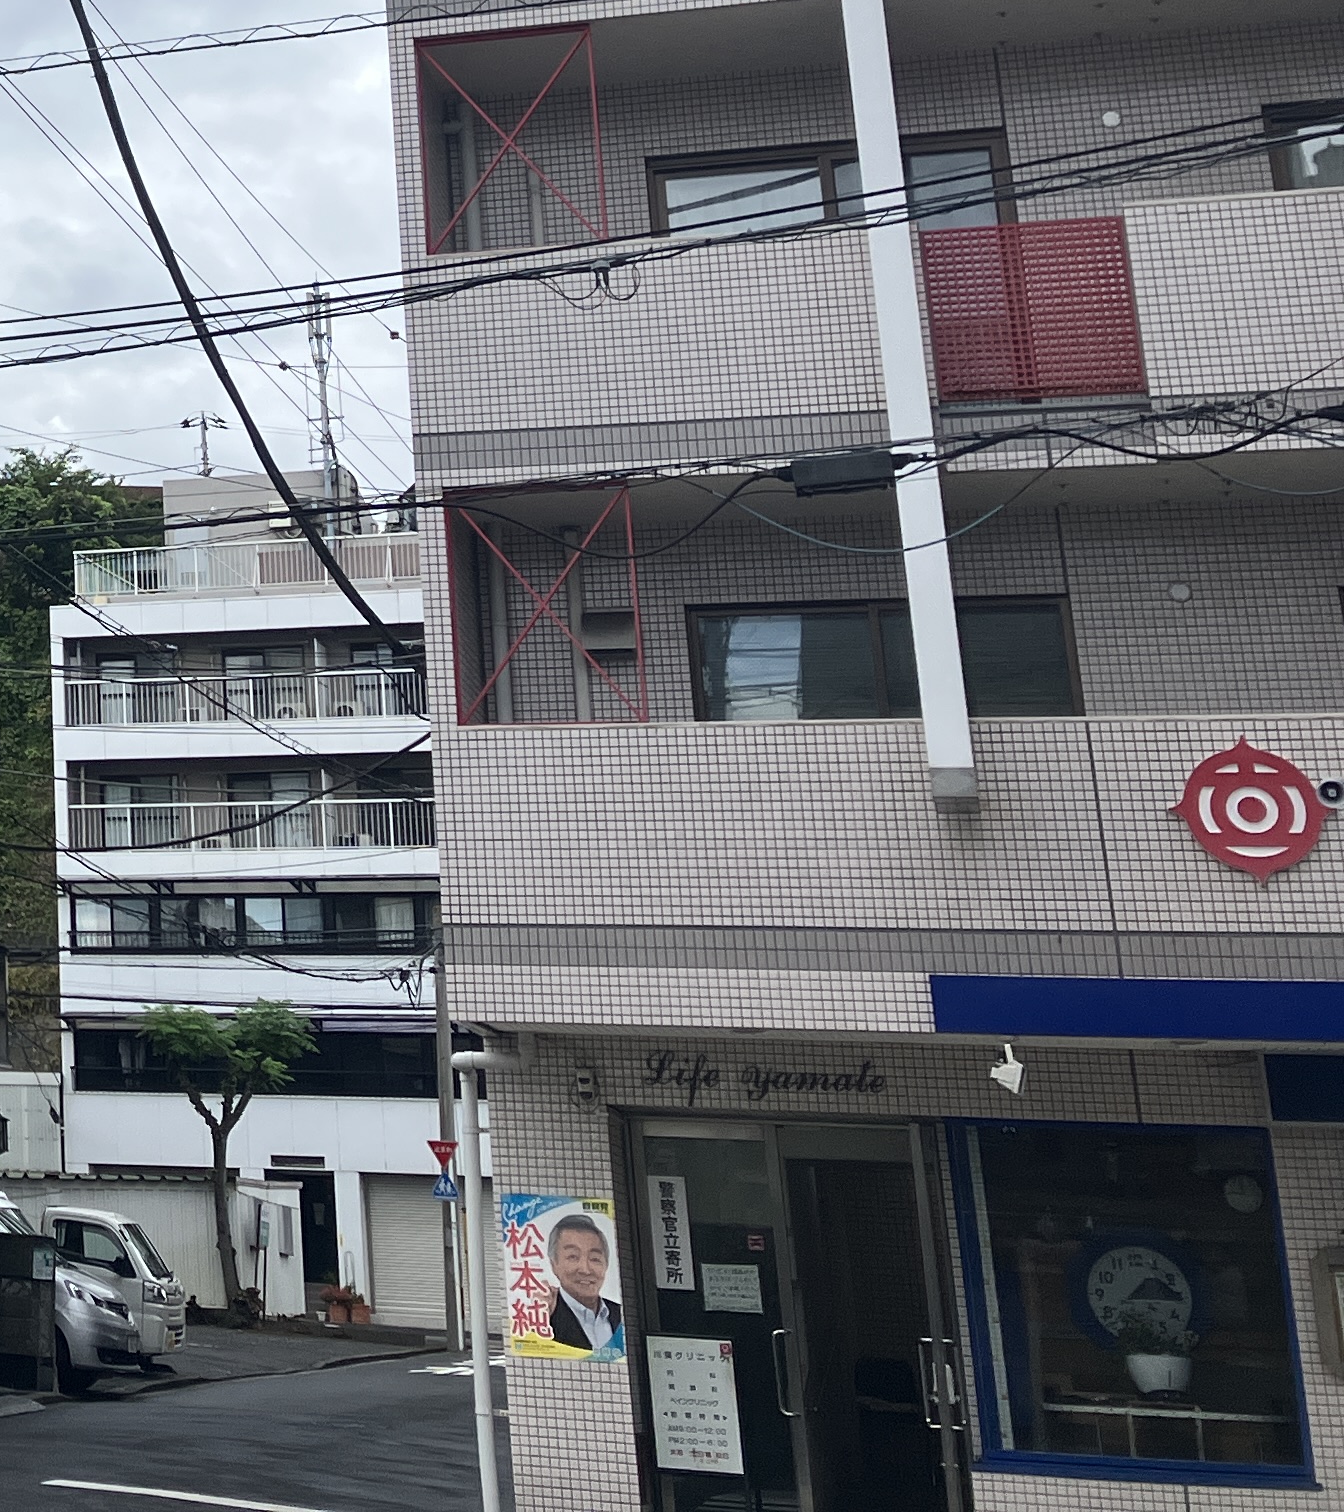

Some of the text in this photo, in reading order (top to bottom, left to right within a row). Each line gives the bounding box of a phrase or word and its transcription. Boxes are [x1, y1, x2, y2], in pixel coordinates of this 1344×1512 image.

[644, 1048, 721, 1107] Life
[506, 1221, 553, 1338] 松本純
[659, 1181, 683, 1285] 警察官立寄所
